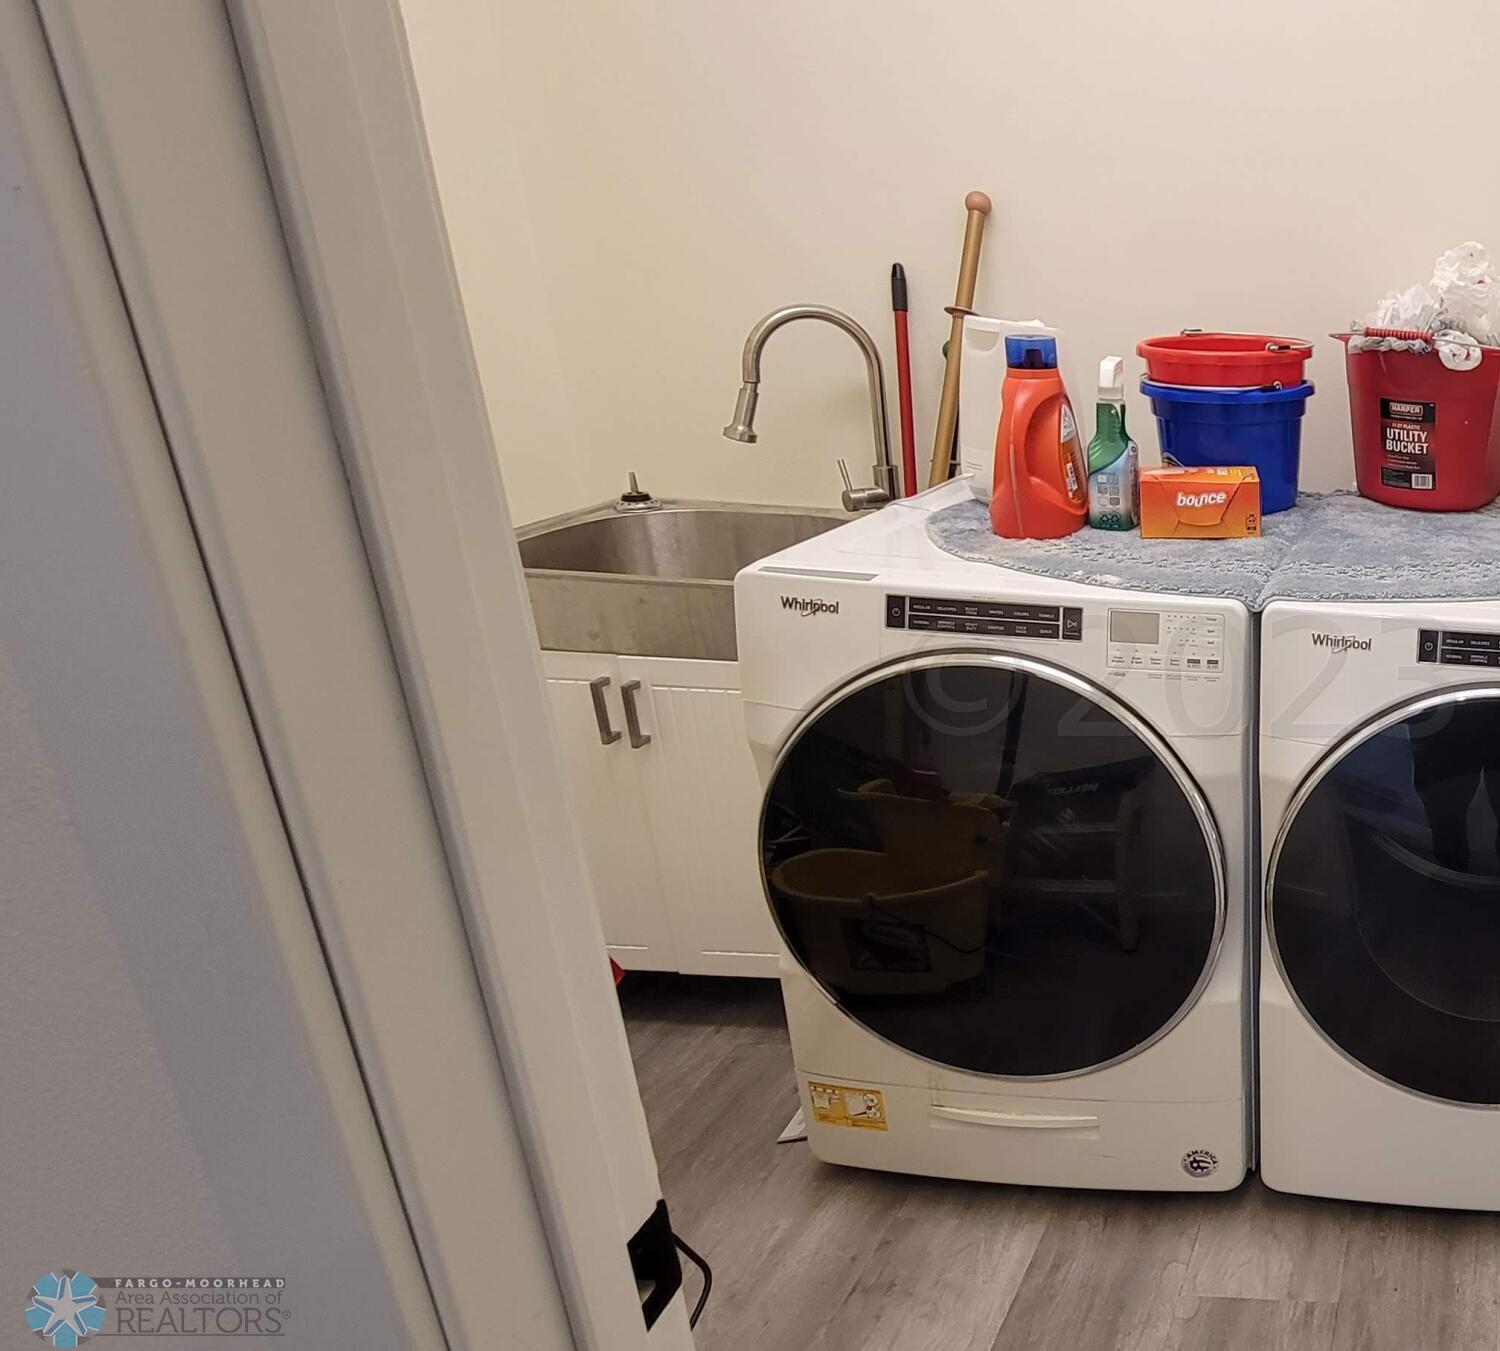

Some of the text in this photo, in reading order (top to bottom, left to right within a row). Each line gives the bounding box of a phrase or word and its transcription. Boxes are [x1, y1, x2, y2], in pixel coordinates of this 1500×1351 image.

[1386, 427, 1427, 443] UTILITY
[1386, 439, 1429, 454] BUCKET
[1176, 491, 1227, 507] bounce
[780, 596, 839, 616] Whirlpool
[1311, 632, 1372, 652] Whirlpool
[1186, 1150, 1218, 1165] AMERICA
